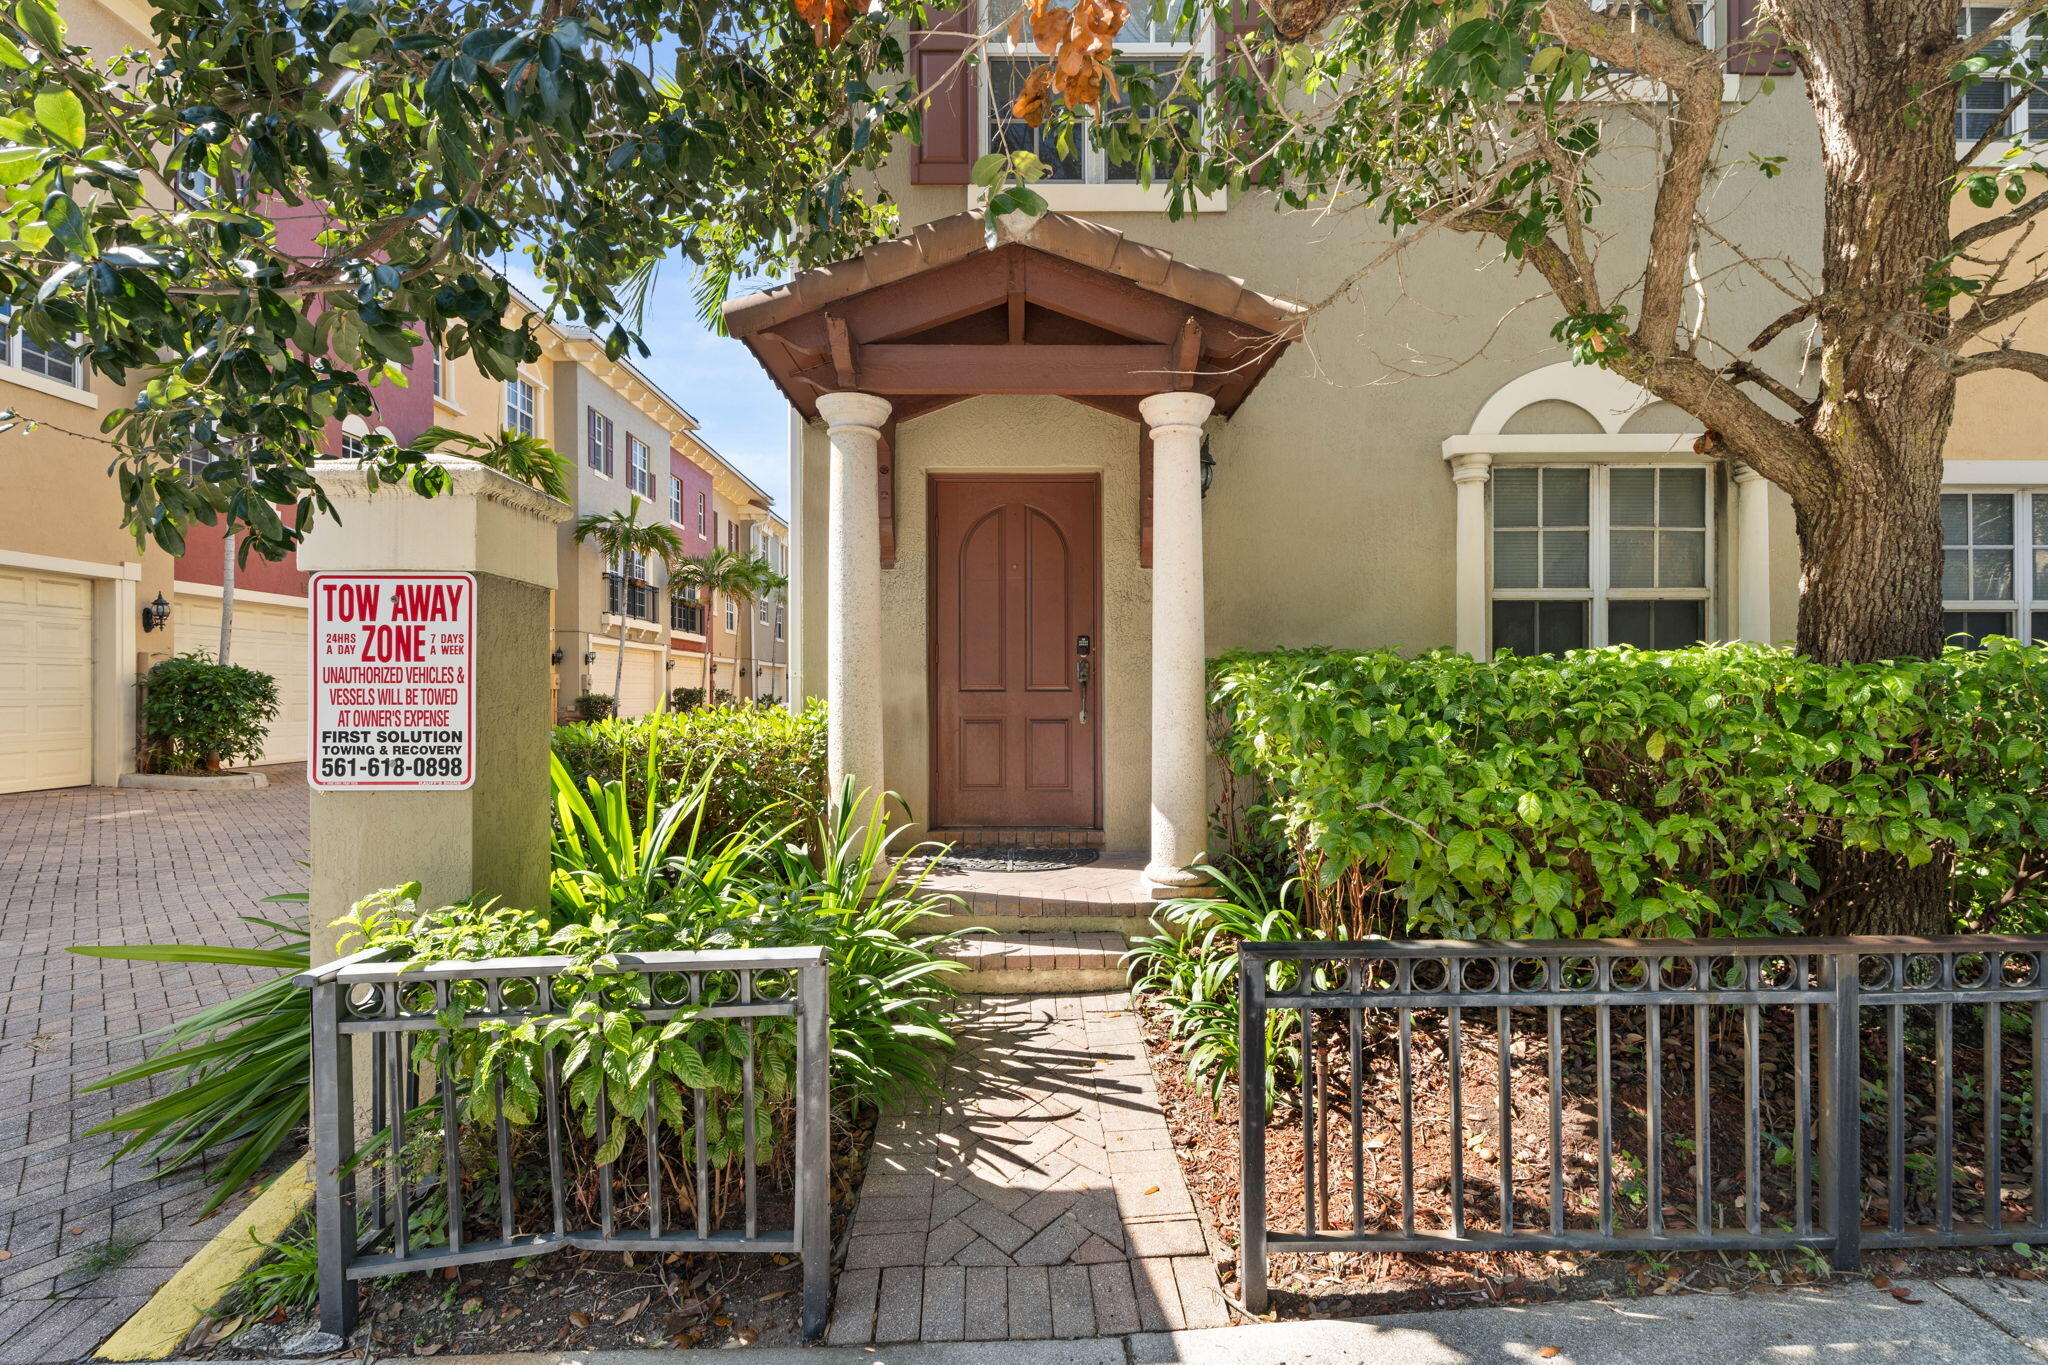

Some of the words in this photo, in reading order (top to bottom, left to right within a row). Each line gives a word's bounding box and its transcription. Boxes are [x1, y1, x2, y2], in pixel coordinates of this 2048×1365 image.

[323, 584, 380, 622] TOW
[391, 584, 463, 622] AWAY
[326, 633, 356, 644] 24HRS
[361, 624, 426, 663] ZONE
[430, 633, 436, 644] 7
[440, 633, 464, 644] DAYS
[326, 645, 333, 655] A
[337, 645, 356, 655] DAY
[430, 645, 437, 655] A
[441, 645, 464, 655] WEEK
[322, 666, 403, 684] UNAUTHORIZED
[405, 666, 454, 684] VEHICLES
[456, 666, 465, 684] &
[329, 688, 375, 706] VESSELS
[377, 688, 403, 706] WILL
[405, 688, 418, 706] BE
[420, 688, 458, 706] TOWED
[337, 710, 351, 727] AT
[353, 710, 401, 727] OWNER'S
[404, 710, 450, 727] EXPENSE
[322, 730, 371, 743] FIRST
[376, 730, 463, 743] SOLUTION
[322, 745, 375, 756] TOWING
[379, 745, 388, 756] &
[392, 745, 462, 756] RECOVERY
[321, 757, 462, 777] 561-618-0898
